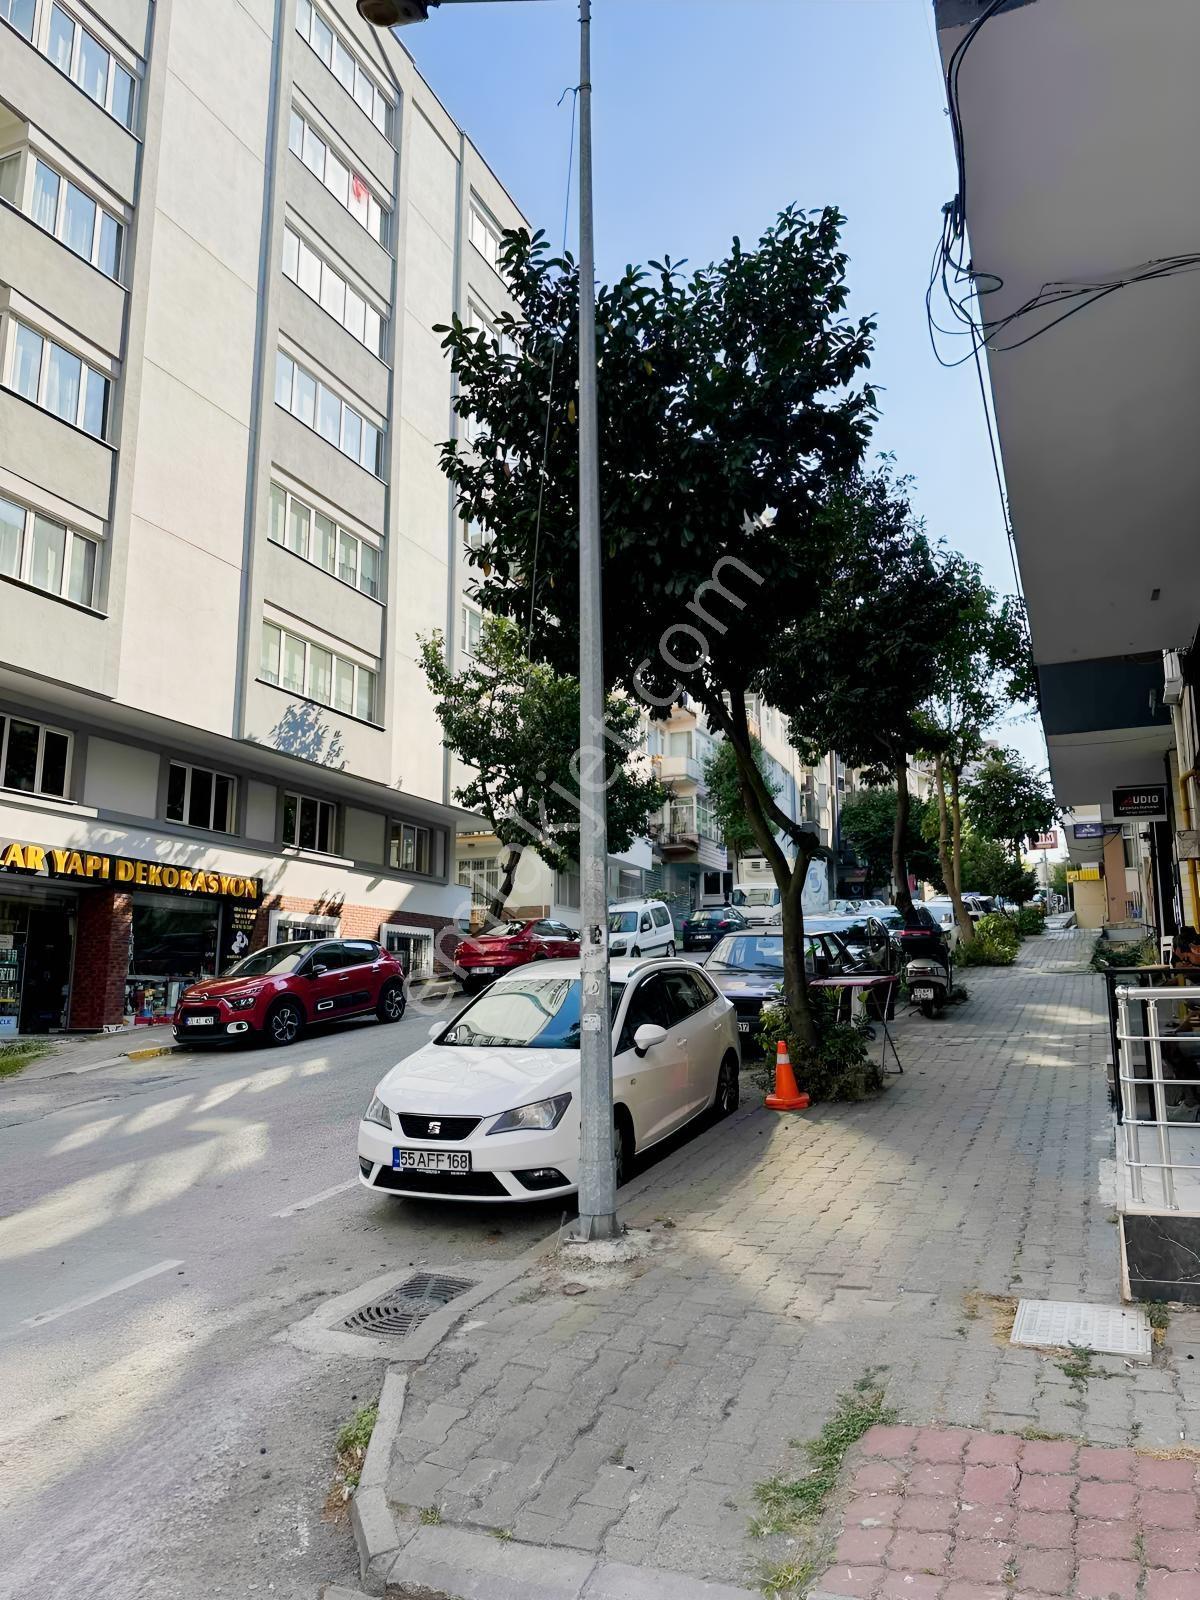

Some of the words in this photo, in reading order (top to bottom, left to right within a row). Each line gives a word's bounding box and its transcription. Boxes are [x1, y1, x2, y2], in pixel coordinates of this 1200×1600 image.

[0, 843, 44, 871] AR
[51, 848, 110, 879] YAPI
[115, 858, 257, 899] DEKORASYON
[400, 1151, 416, 1167] 55
[416, 1152, 444, 1169] AFF
[447, 1154, 468, 1170] 168
